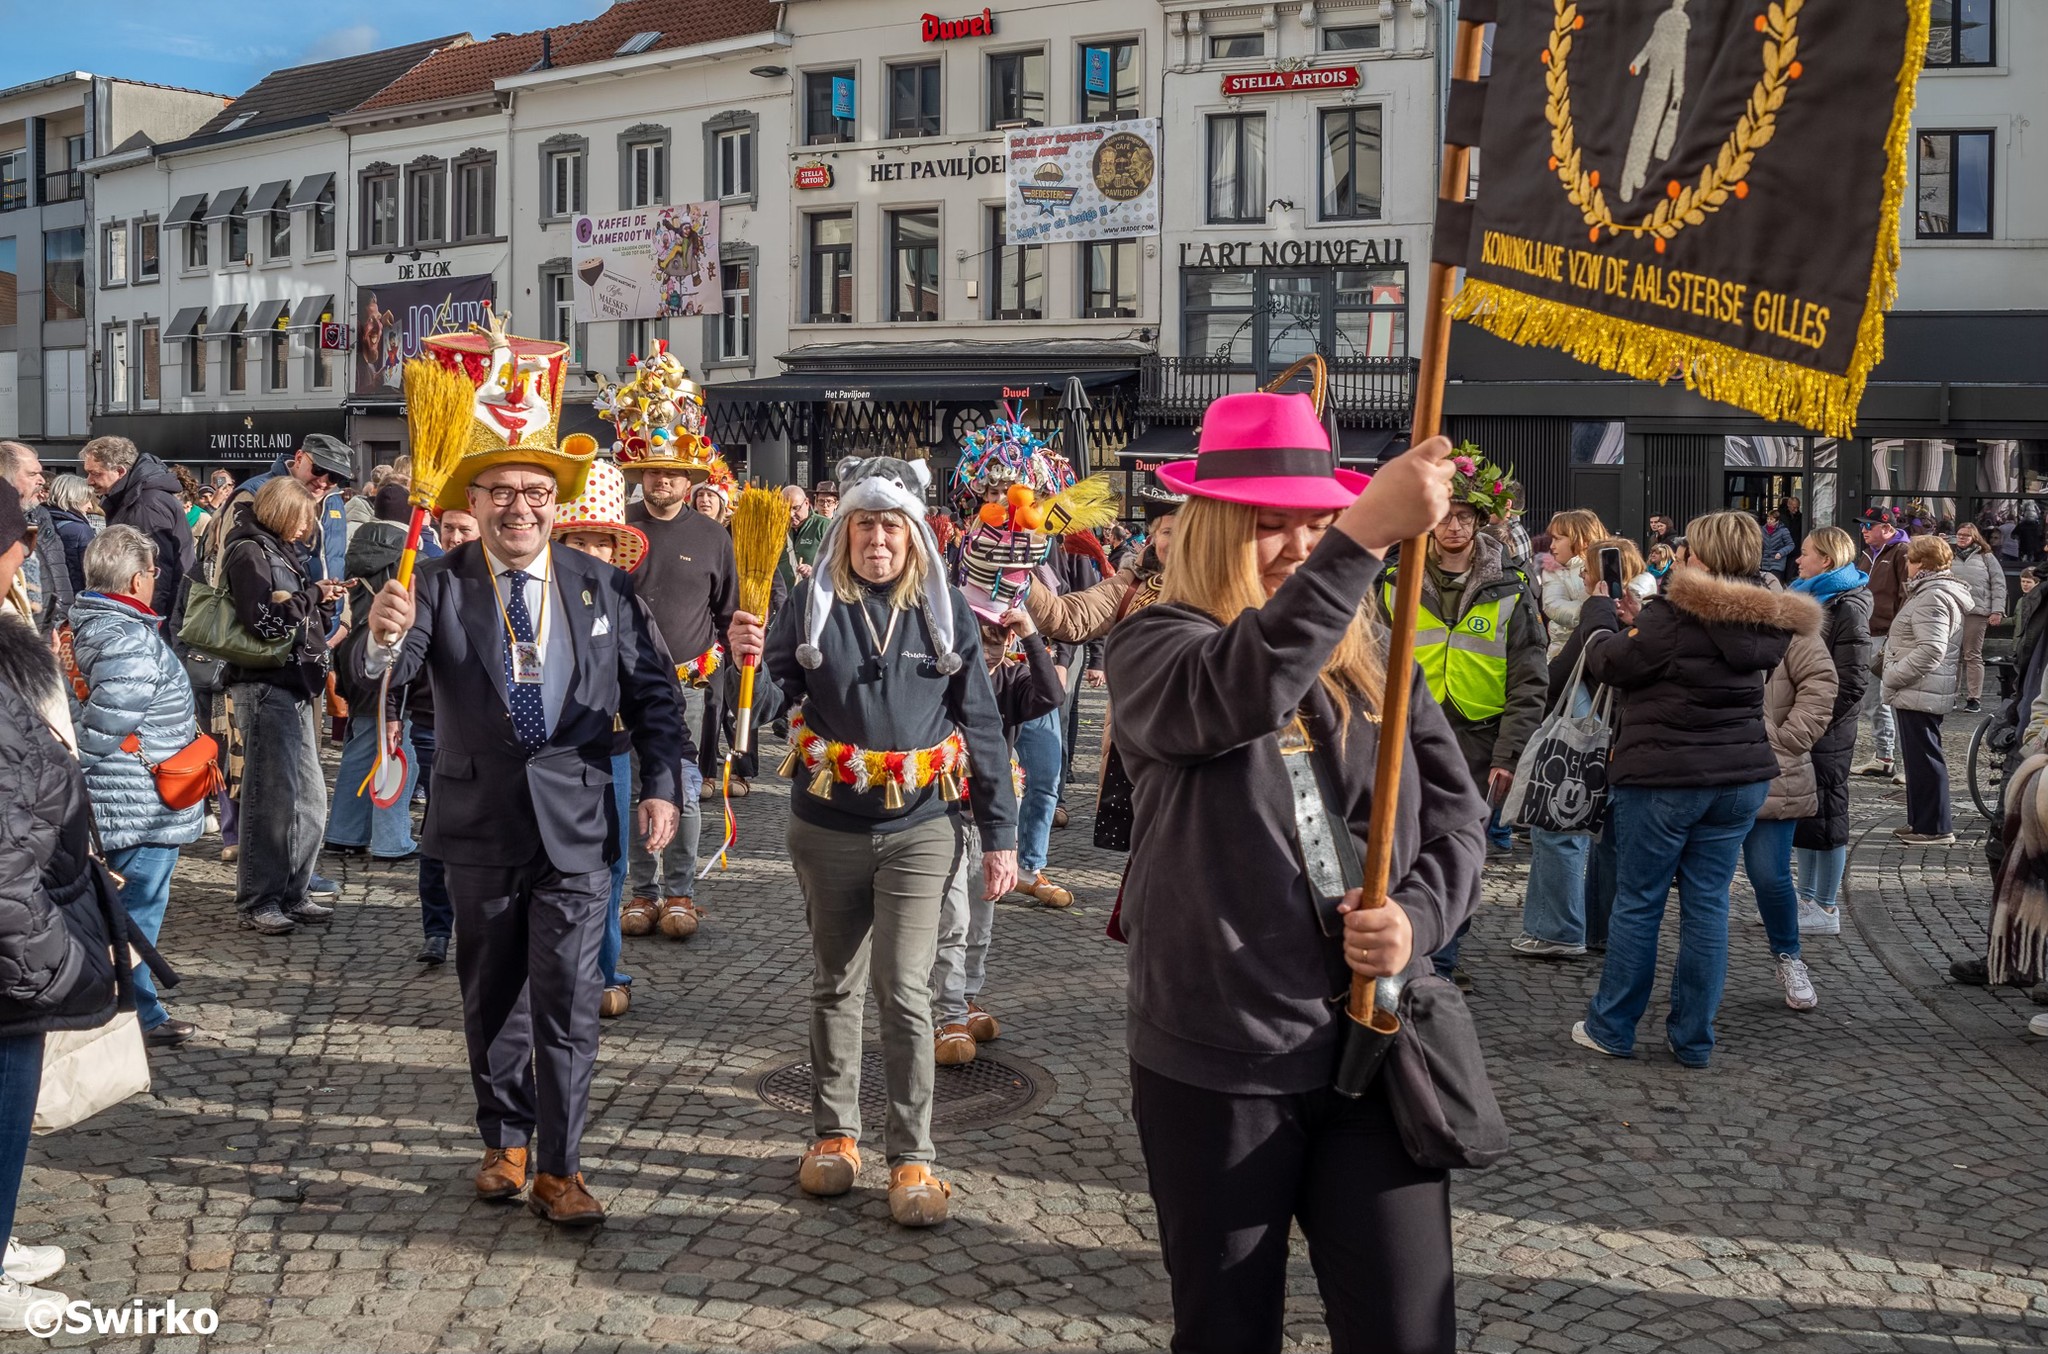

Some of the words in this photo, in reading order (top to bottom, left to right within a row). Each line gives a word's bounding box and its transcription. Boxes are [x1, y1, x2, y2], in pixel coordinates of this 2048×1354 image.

[920, 7, 993, 42] Duvel
[1232, 76, 1285, 90] STELLA
[1292, 70, 1347, 85] ARTOIS
[801, 170, 823, 178] STELLA
[870, 163, 904, 182] HET
[1105, 189, 1139, 197] PAVILJOEN
[598, 216, 631, 230] KAFFEI
[634, 214, 647, 226] DE
[592, 229, 651, 245] KAMEROOT'N
[1179, 241, 1252, 267] L'ART
[1259, 238, 1403, 266] NOUVEAU
[398, 264, 414, 280] DE
[418, 261, 452, 278] KLOK
[1481, 230, 1565, 283] KONINKLIJKE
[1568, 249, 1603, 291] VZW
[1605, 257, 1628, 298] DE
[1631, 263, 1747, 327] AALSTERSE
[1753, 290, 1831, 350] GILLES
[599, 293, 629, 312] MAESKES
[825, 390, 837, 399] Het
[839, 389, 870, 399] Paviljoen
[1003, 386, 1030, 398] Duvel
[210, 433, 292, 449] ZWITSERLAND
[1473, 619, 1484, 631] B
